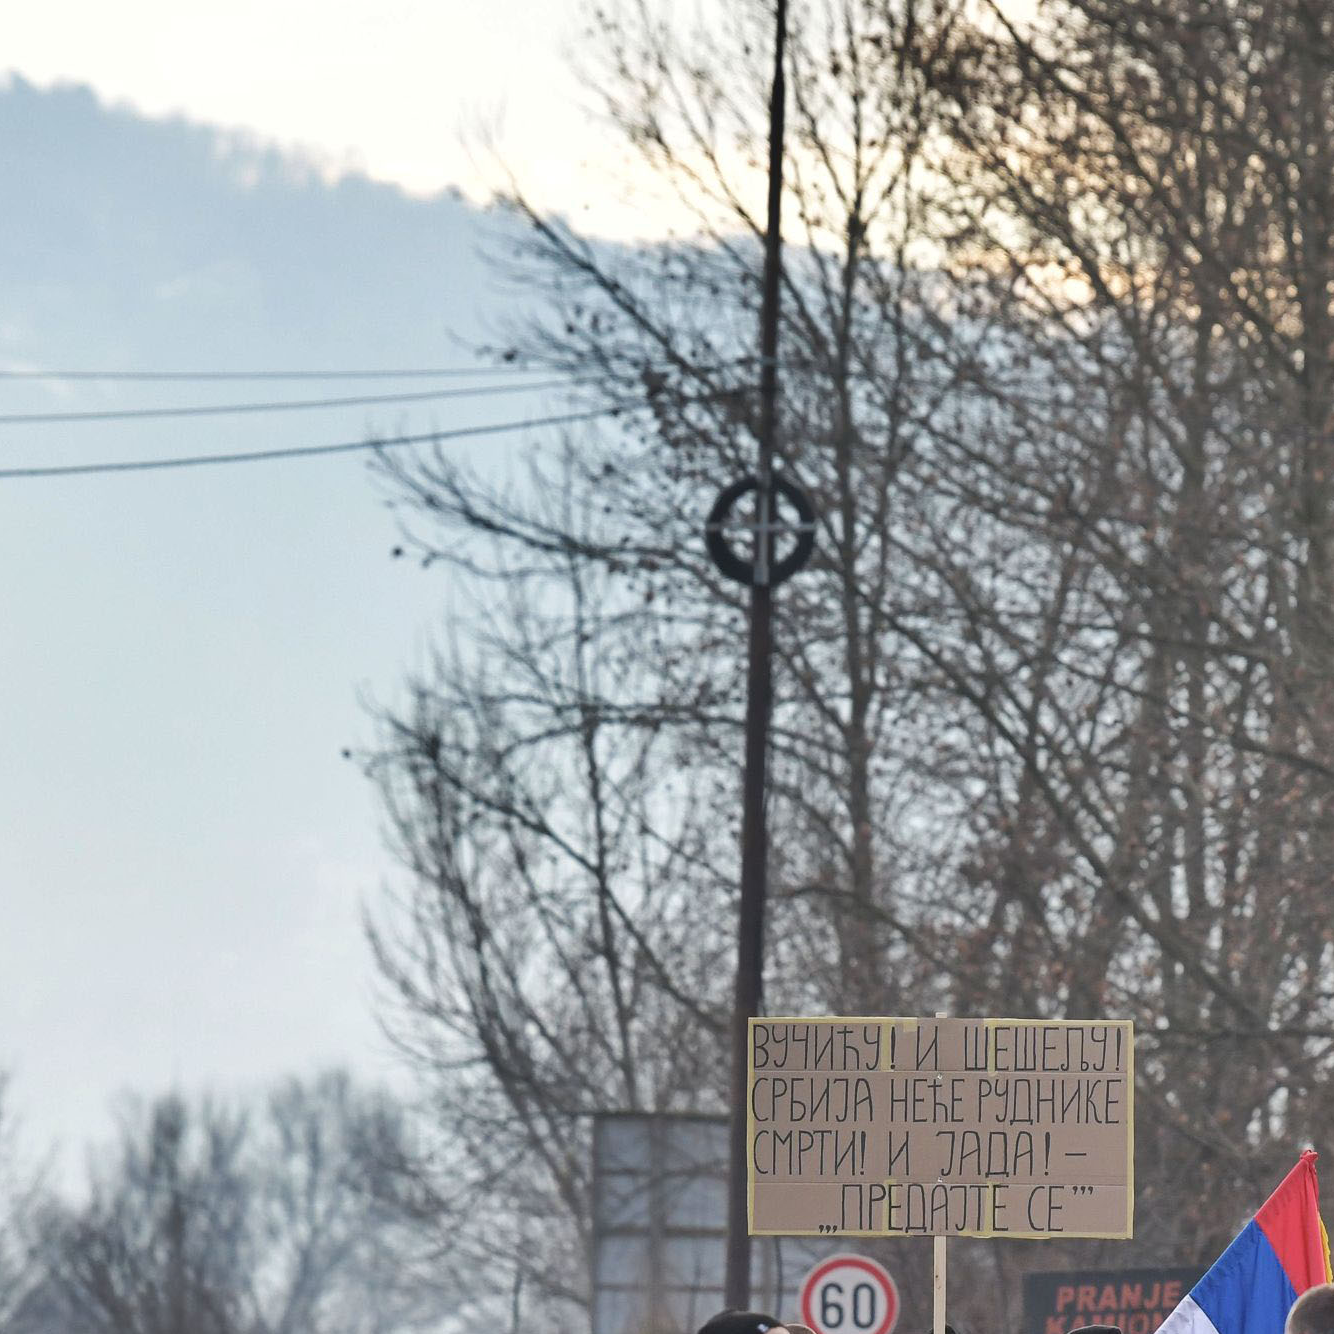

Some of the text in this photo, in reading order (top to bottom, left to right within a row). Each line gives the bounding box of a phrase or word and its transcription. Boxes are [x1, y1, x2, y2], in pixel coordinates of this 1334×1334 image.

[915, 1026, 938, 1070] И
[965, 1026, 1122, 1072] ШЕШЕЉУ!
[751, 1073, 1122, 1125] СРБИЈА НЕЋЕ РУДНИКЕ
[753, 1130, 867, 1176] СМРТИ!
[888, 1131, 910, 1176] И
[821, 1282, 875, 1329] 60
[1056, 1280, 1184, 1314] PRANJE
